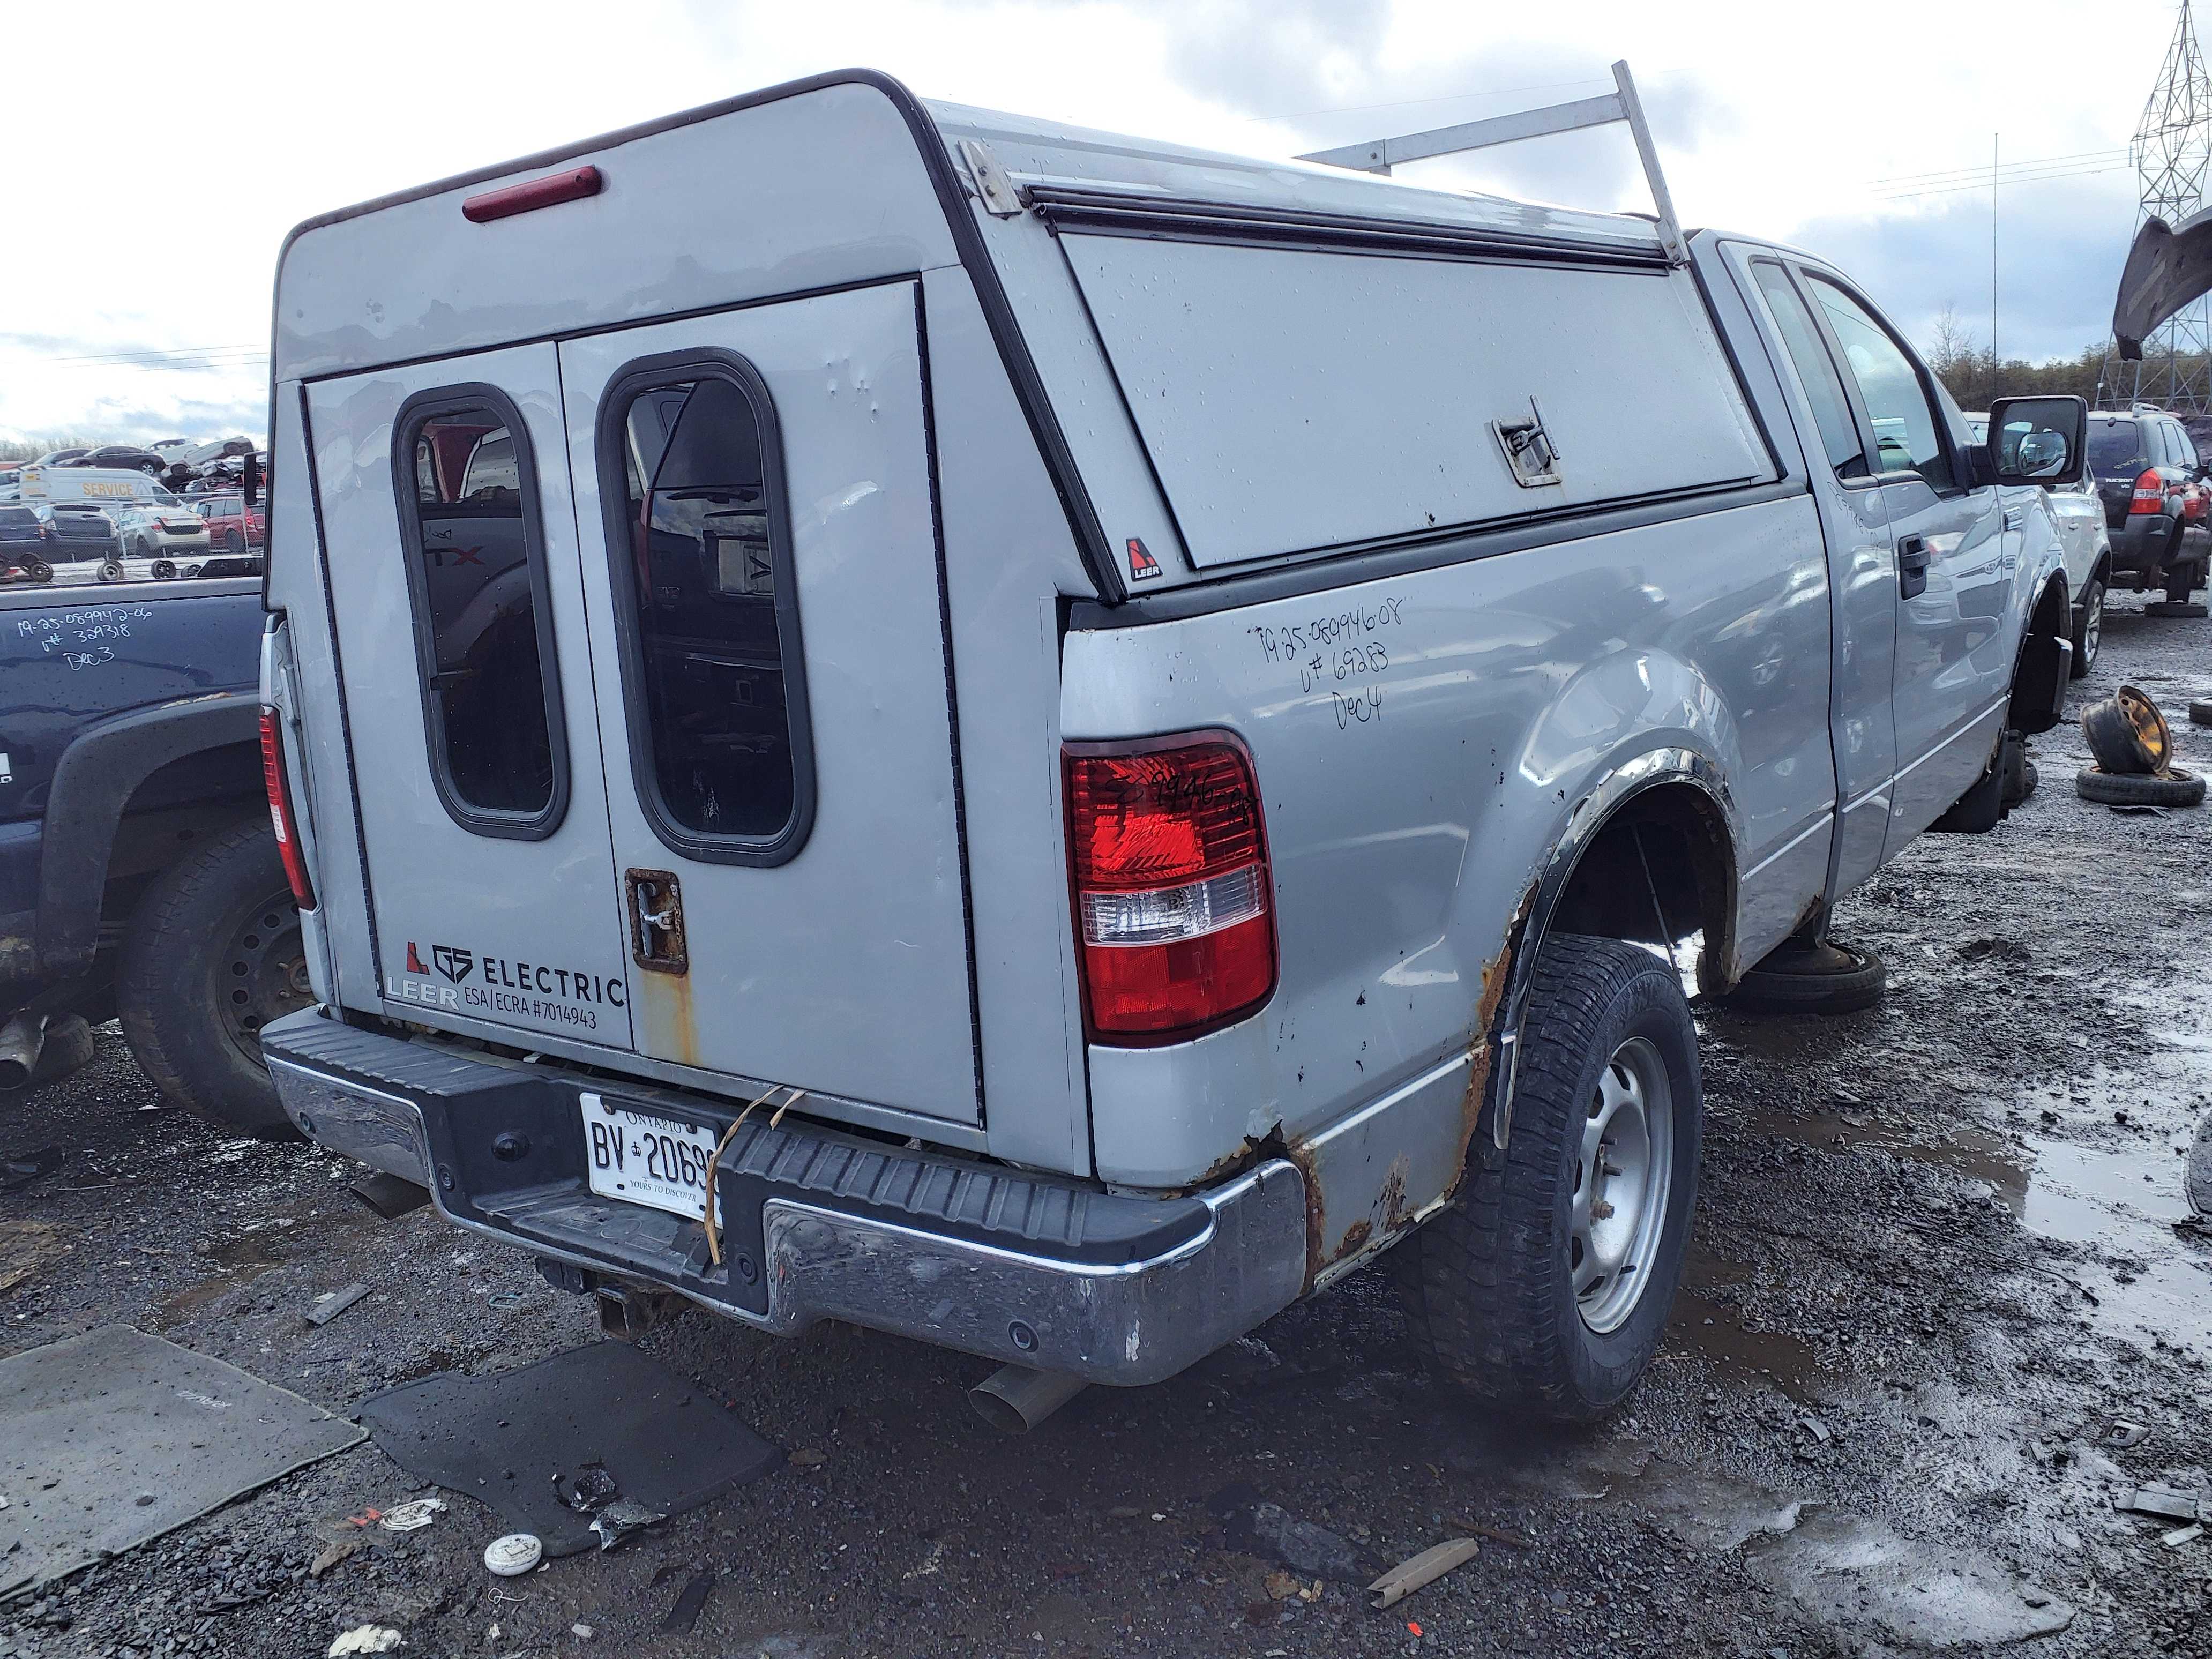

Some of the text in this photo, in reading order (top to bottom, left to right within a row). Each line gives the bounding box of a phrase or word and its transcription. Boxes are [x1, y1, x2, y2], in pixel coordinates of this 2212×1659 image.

[82, 482, 134, 495] SERVICE
[1134, 566, 1160, 579] LEER
[72, 623, 131, 642] 329318
[1333, 642, 1388, 680] 69283
[387, 976, 460, 1011] LEER
[483, 957, 625, 1007] ELECTRIC
[533, 1000, 596, 1029] #7014943
[626, 1110, 682, 1134] ONTARIO
[591, 1122, 623, 1170] BV
[630, 1180, 697, 1202] YOURS TO DISCOVER
